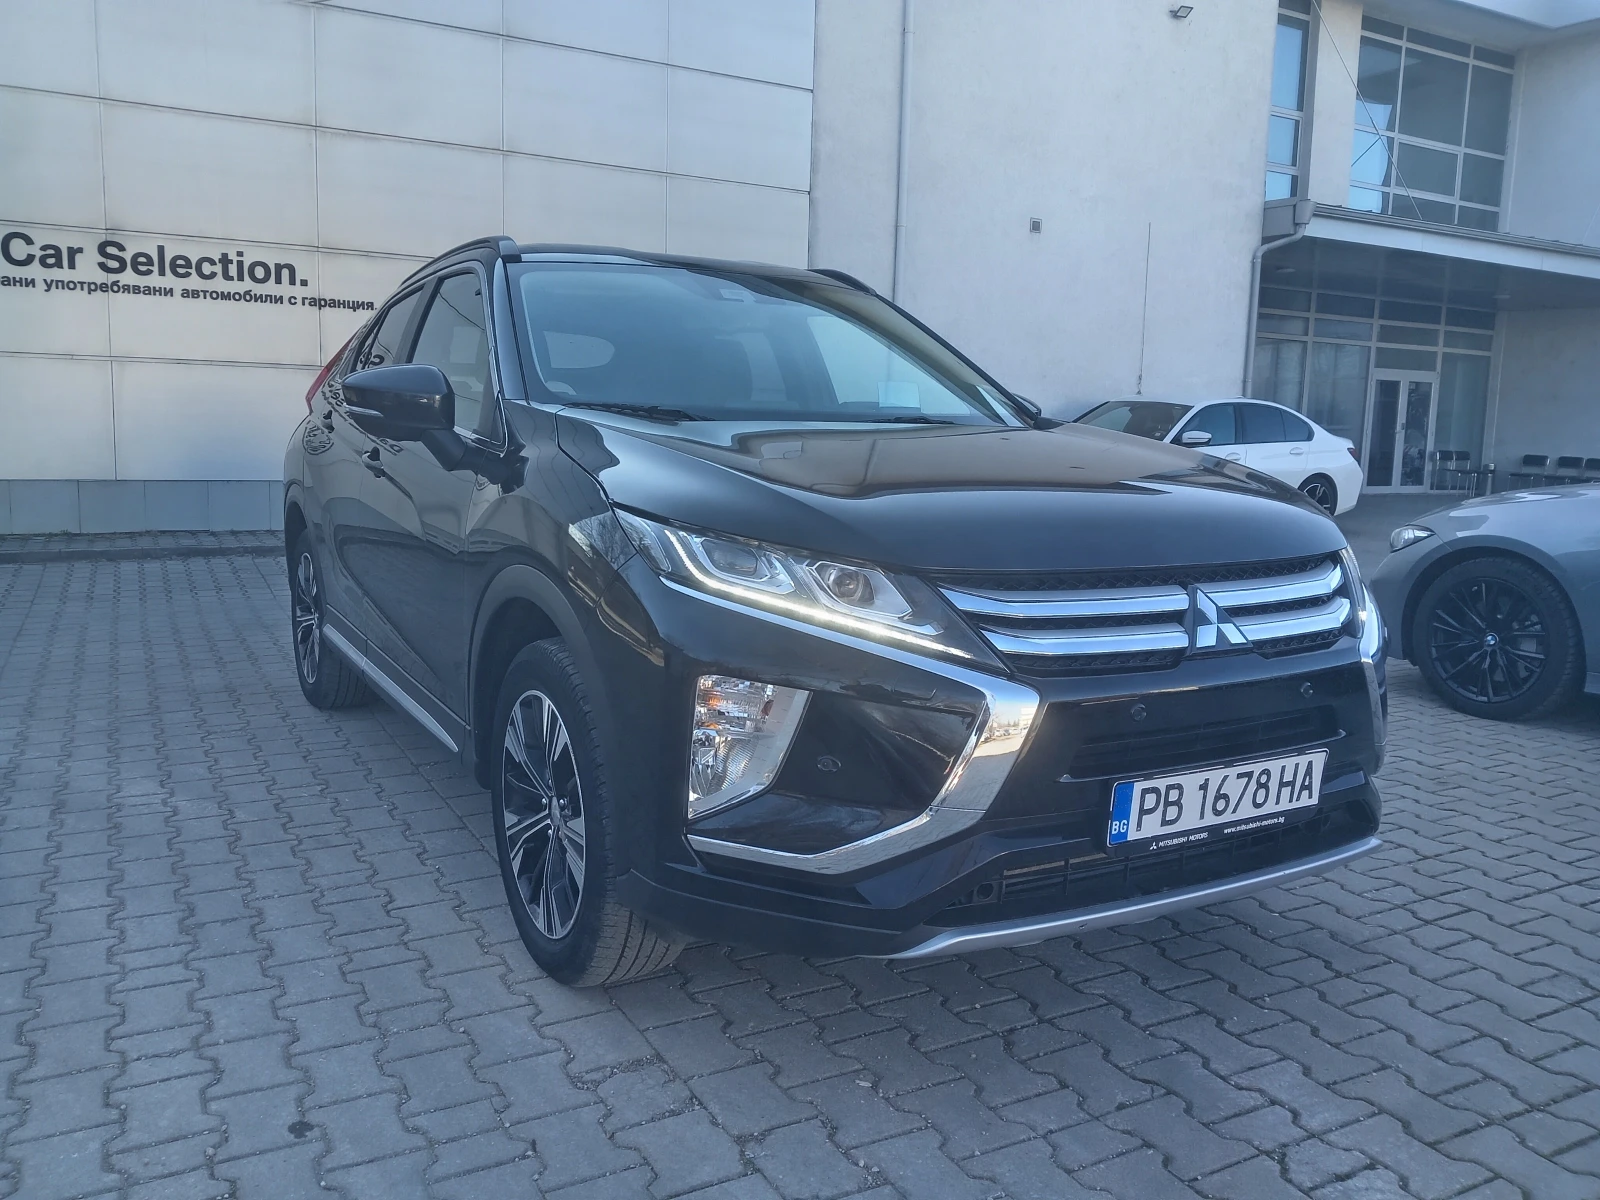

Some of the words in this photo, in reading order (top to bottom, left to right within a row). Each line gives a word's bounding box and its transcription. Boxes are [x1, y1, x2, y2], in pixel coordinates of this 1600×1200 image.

[1, 231, 84, 270] Car
[97, 240, 309, 287] Selection.
[43, 278, 174, 298] употребявани
[180, 287, 284, 305] автомобили
[288, 295, 298, 305] с
[1136, 782, 1184, 832] PB
[1198, 768, 1272, 820] 1678
[1275, 760, 1314, 805] HA
[1111, 820, 1128, 835] BG
[1223, 816, 1285, 834] www.mitsubishi-motors.bg
[1158, 836, 1188, 848] MITSUBISHI
[1188, 831, 1208, 843] MOTORS
